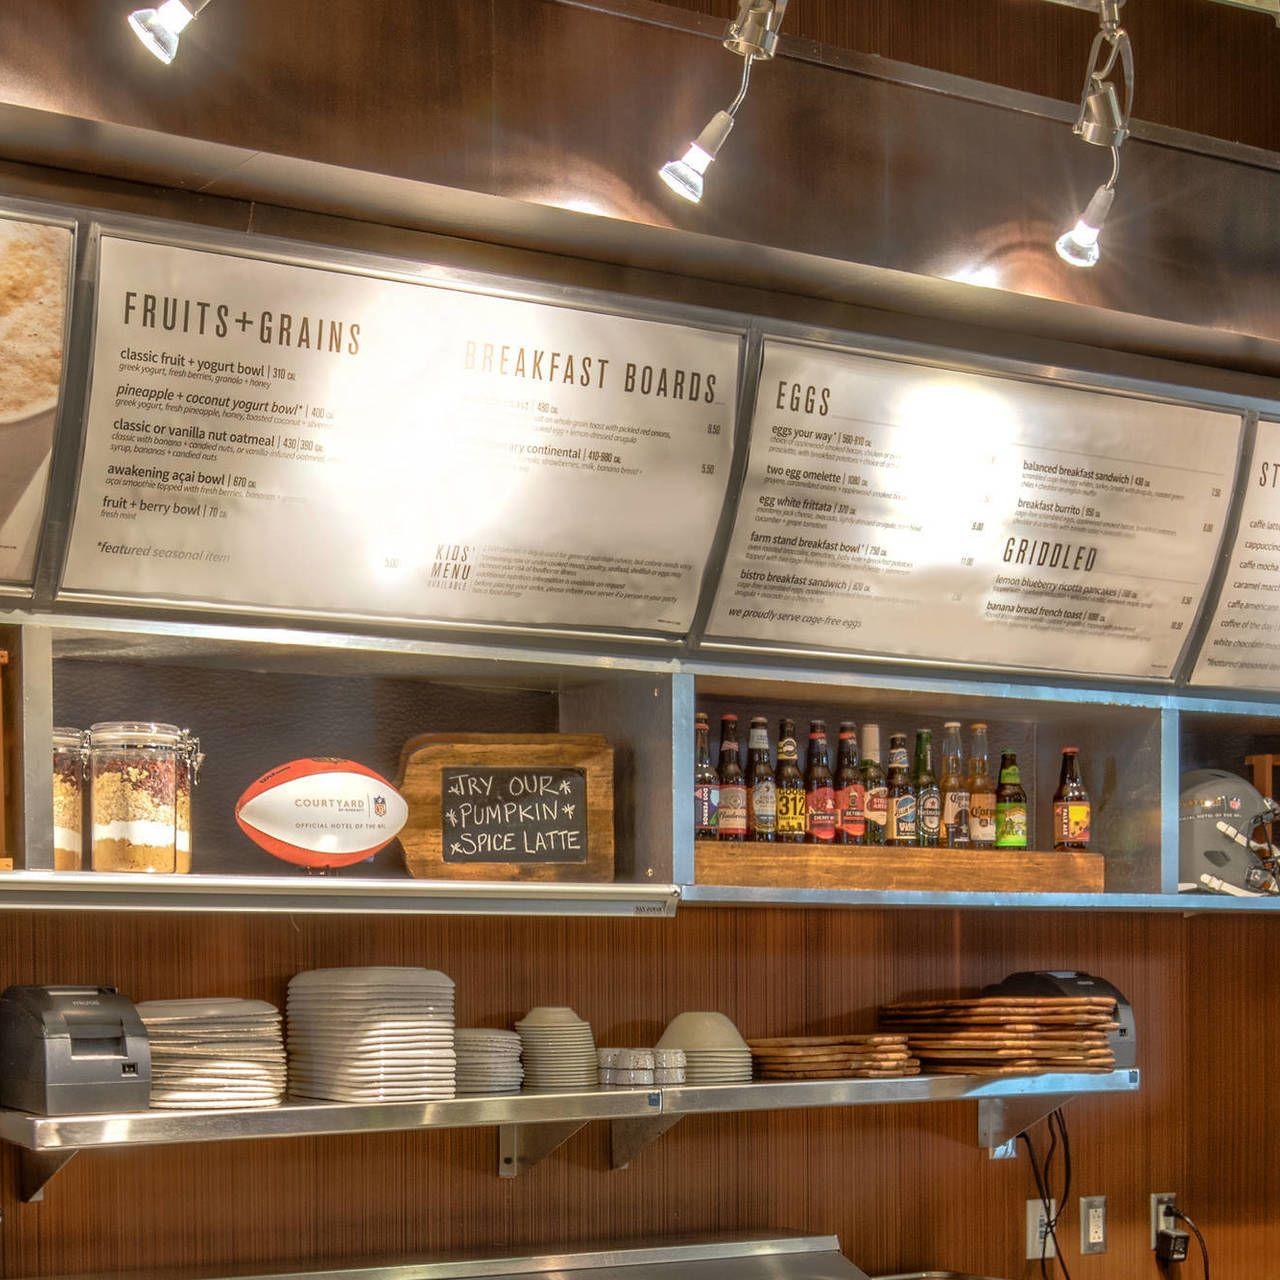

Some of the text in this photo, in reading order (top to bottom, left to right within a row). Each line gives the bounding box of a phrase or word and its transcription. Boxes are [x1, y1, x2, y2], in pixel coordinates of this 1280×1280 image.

[124, 292, 361, 355] FRUITS+GRAINS
[120, 348, 265, 377] classic fruit yogurt bowl
[464, 340, 717, 404] BREAKFAST BOARDS
[116, 384, 269, 413] pineapple coconut yogurt
[776, 381, 831, 416] EGGS
[113, 419, 151, 434] classic
[169, 424, 205, 441] vanilla
[230, 431, 275, 448] oatmeal
[107, 463, 225, 487] awakening bowl
[785, 469, 841, 484] egg omelette
[1023, 460, 1129, 485] balanced breakfast sandwich
[102, 496, 201, 518] fruit berry bowl
[759, 496, 832, 513] egg white frittata
[1018, 498, 1080, 516] breakfast burrito
[751, 531, 839, 552] farm stand breakfast
[1003, 538, 1097, 572] GRIDDLED
[431, 562, 471, 580] MENU
[740, 570, 847, 591] bistro breakfast sandwich
[742, 608, 776, 622] proudly
[986, 601, 1062, 619] banana bread french
[449, 773, 560, 797] TRY OUR
[295, 799, 364, 808] COURTYARD
[461, 802, 559, 827] PUMPKIN
[460, 830, 581, 857] SPICE LATTE
